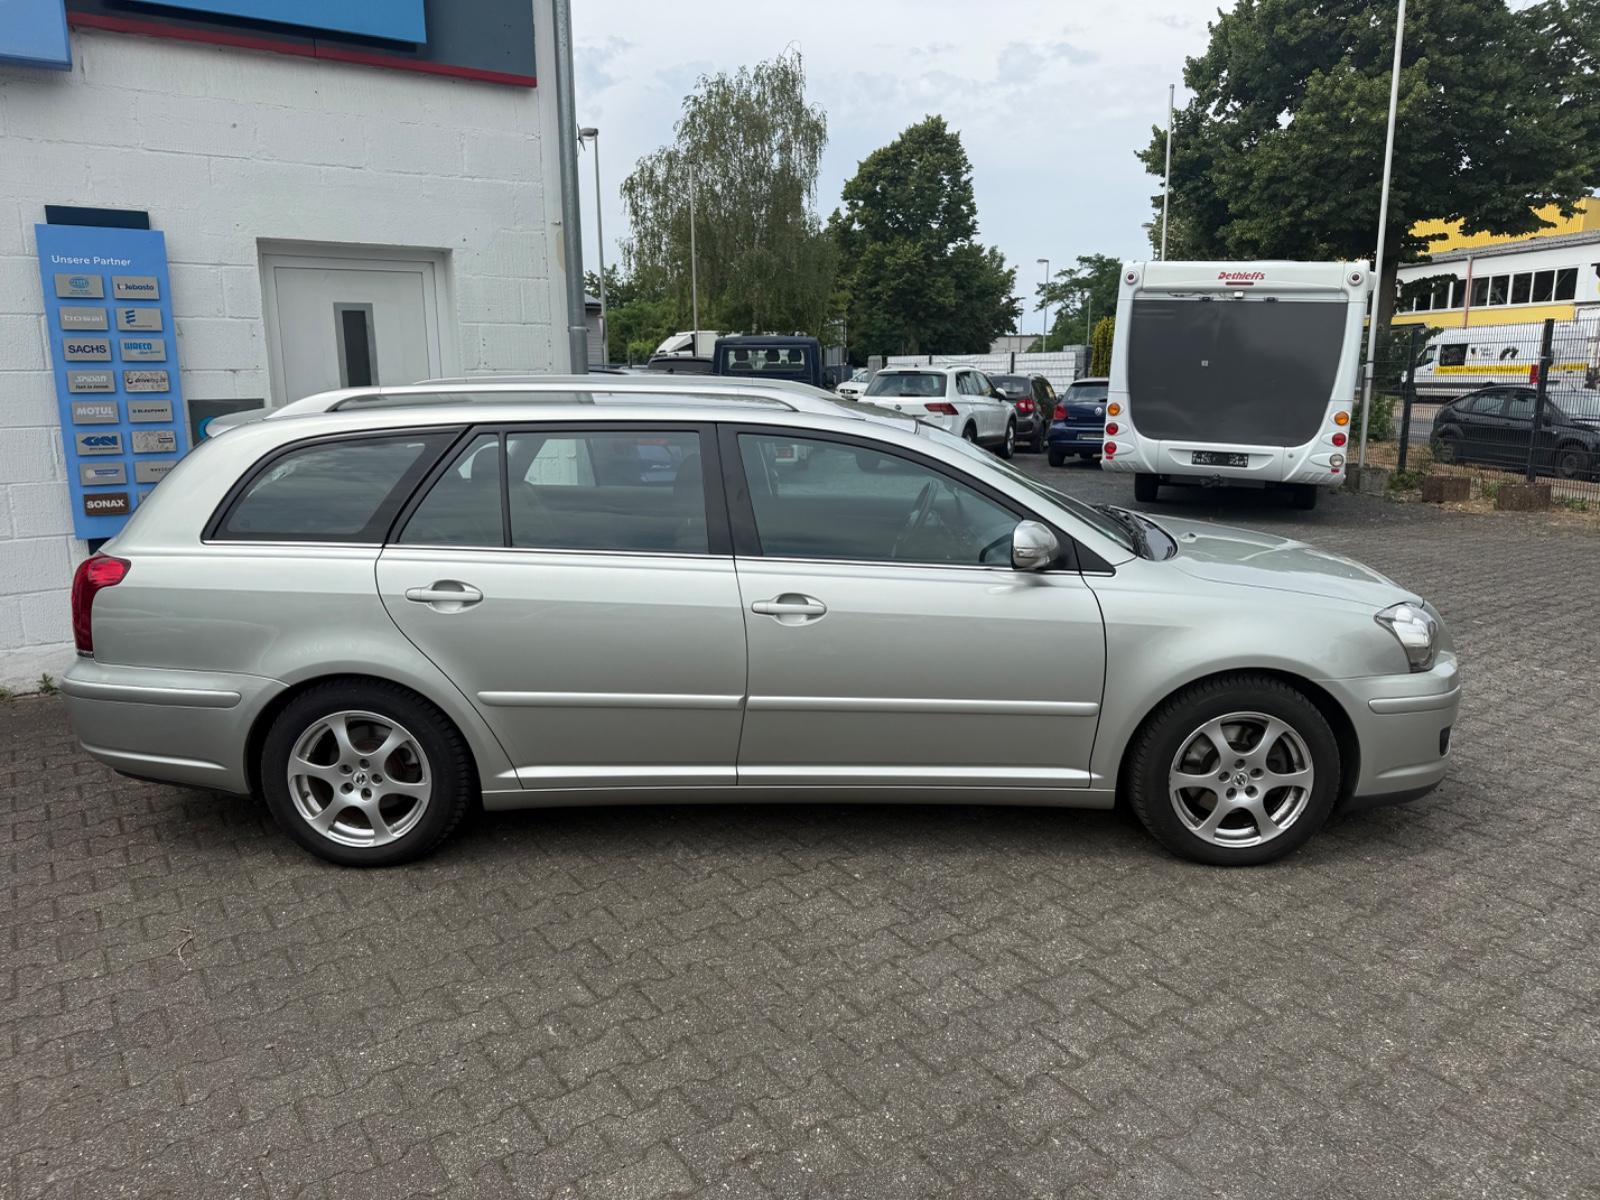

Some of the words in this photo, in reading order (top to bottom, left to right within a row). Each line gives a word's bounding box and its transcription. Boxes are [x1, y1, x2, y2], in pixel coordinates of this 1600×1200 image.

[51, 255, 91, 265] Unsere
[93, 256, 132, 267] Partner
[1217, 271, 1266, 281] Dethleffs
[68, 344, 107, 354] SACHS
[76, 407, 113, 416] MOTUL
[86, 499, 125, 509] SONAX
